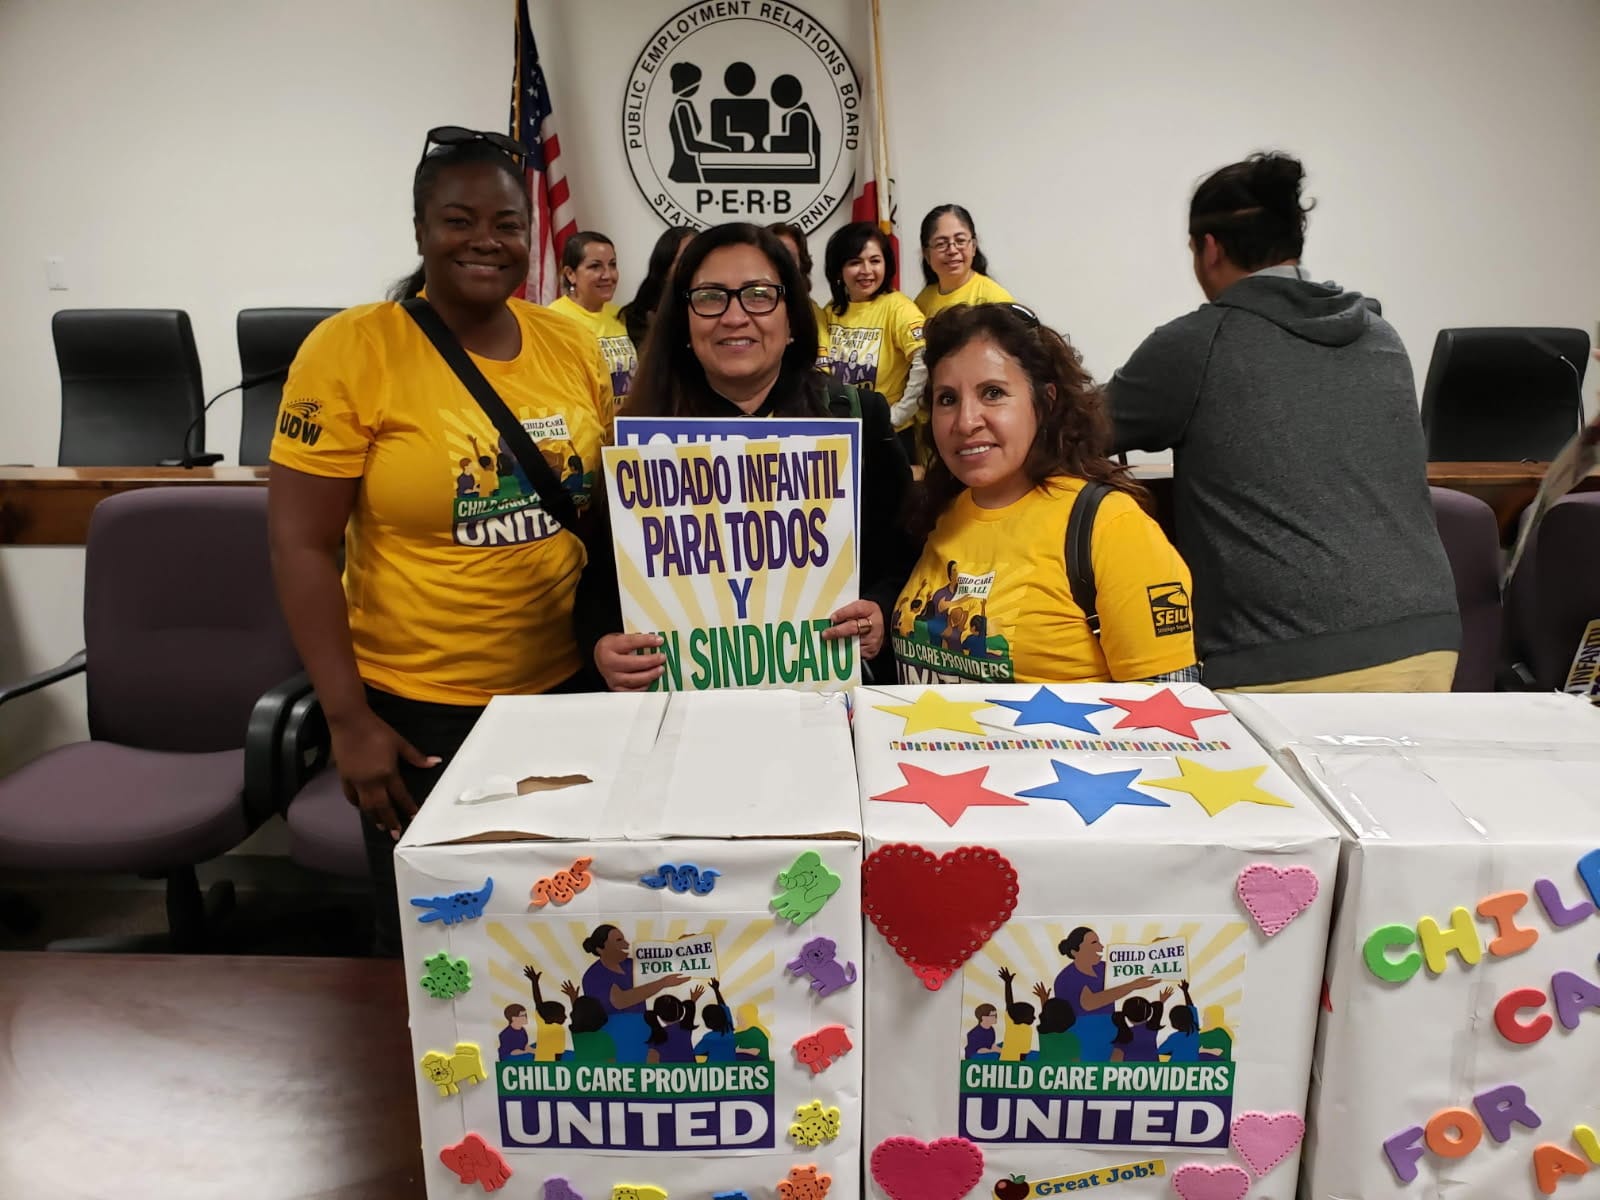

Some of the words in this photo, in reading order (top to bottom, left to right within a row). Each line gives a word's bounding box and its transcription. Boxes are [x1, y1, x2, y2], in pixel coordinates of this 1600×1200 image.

[628, 79, 646, 149] PUBLIC
[641, 1, 751, 74] EMPLOYMENT
[760, 3, 845, 76] RELATIONS
[840, 83, 859, 150] BOARD
[280, 410, 323, 446] UDW
[550, 427, 566, 436] ALL
[616, 455, 732, 509] CUIDADO
[737, 450, 845, 503] INFANTIL
[642, 513, 726, 577] PARA
[725, 507, 829, 572] TODOS
[727, 577, 753, 619] Y
[970, 585, 987, 594] ALL
[1156, 608, 1188, 626] SEIU
[689, 618, 853, 690] SINDICATO
[916, 643, 940, 666] CARE
[940, 651, 1010, 679] PROVIDERS
[635, 947, 673, 959] CHILD
[676, 941, 713, 955] CARE
[640, 961, 673, 974] FOR
[680, 957, 711, 971] ALL
[1109, 950, 1146, 963] CHILD
[1149, 945, 1185, 961] CARE
[1113, 965, 1145, 977] FOR
[1151, 961, 1182, 974] ALL
[502, 1066, 571, 1091] CHILD
[576, 1066, 636, 1093] CARE
[640, 1065, 769, 1093] PROVIDERS
[966, 1063, 1034, 1090] CHILD
[1039, 1065, 1098, 1091] CARE
[1102, 1066, 1229, 1092] PROVIDERS
[505, 1100, 769, 1147] UNITED
[965, 1097, 1225, 1143] UNITED
[1383, 1085, 1542, 1183] FOR
[1035, 1174, 1100, 1196] Great
[1106, 1162, 1156, 1183] Job!
